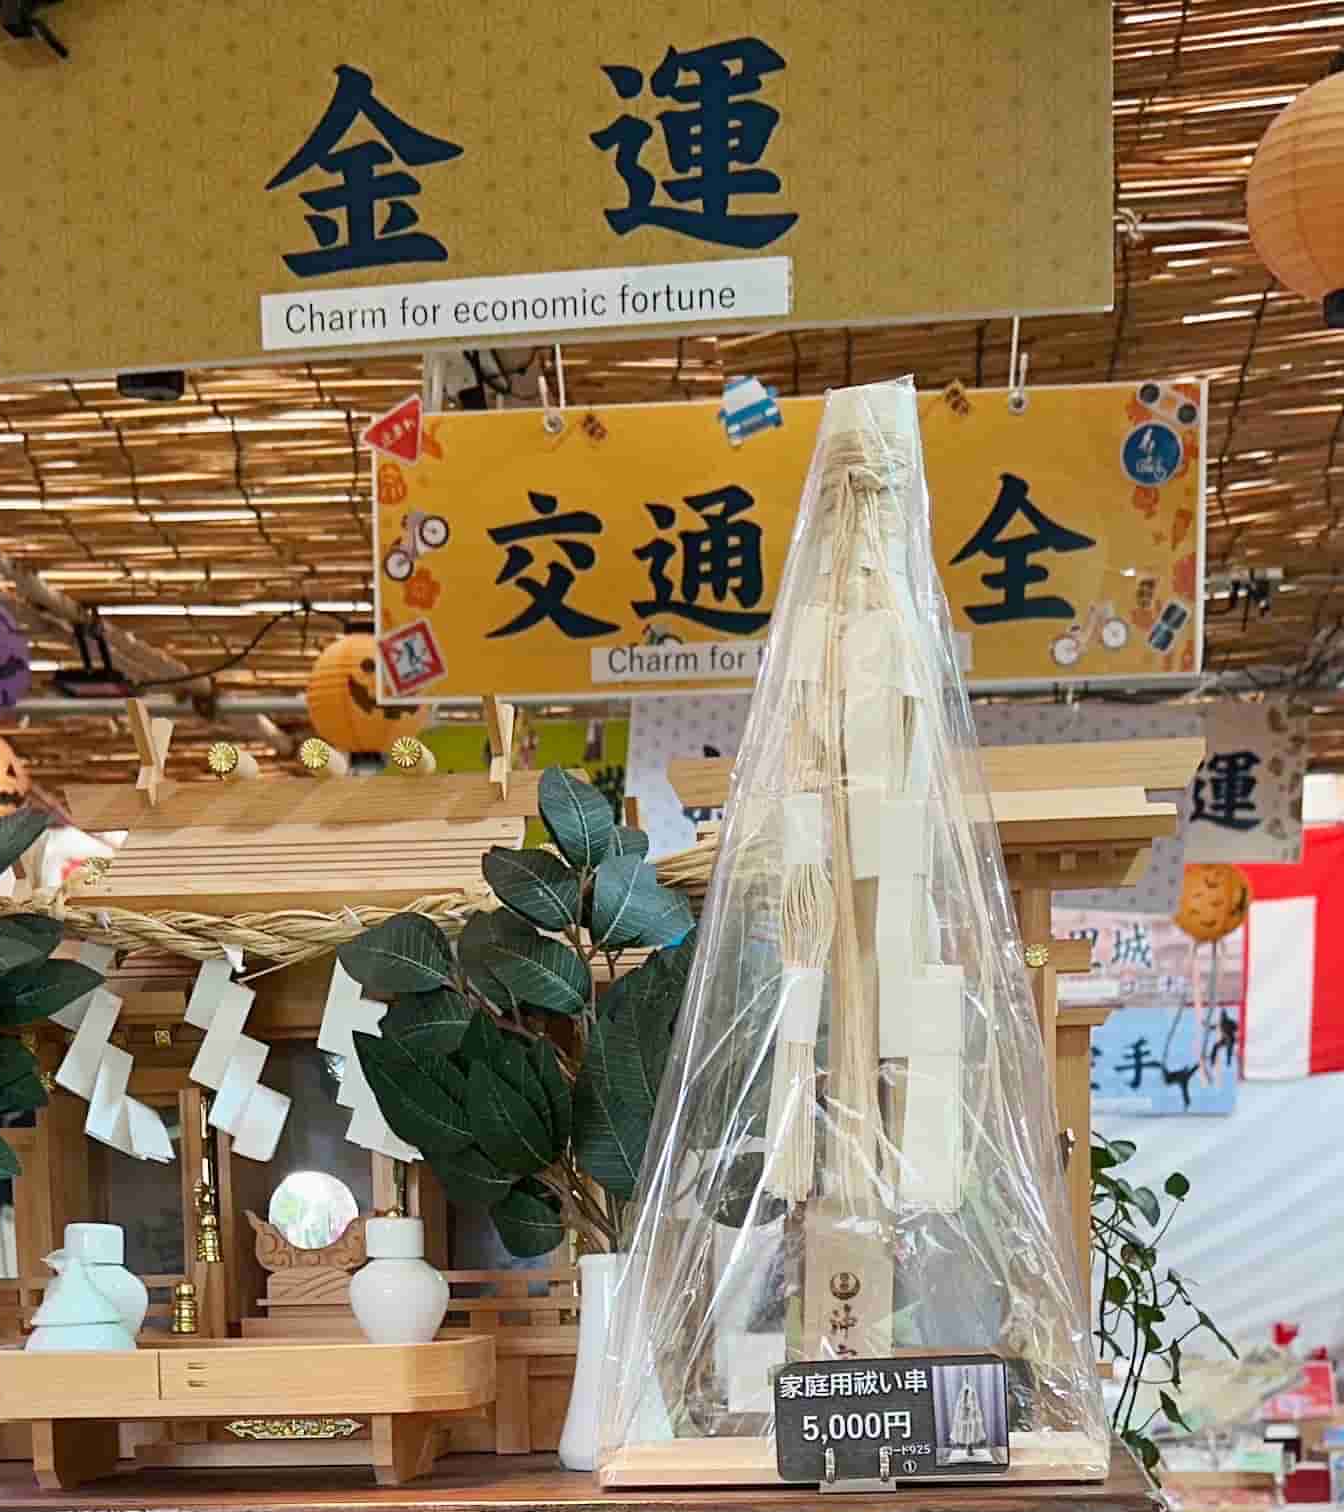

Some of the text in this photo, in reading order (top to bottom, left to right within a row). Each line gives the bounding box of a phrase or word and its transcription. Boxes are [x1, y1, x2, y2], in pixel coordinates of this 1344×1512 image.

[285, 283, 736, 334] Charm for economic fortune
[607, 645, 701, 674] Charm
[707, 644, 746, 672] for
[778, 1368, 929, 1400] 家庭用祓い串
[802, 1411, 913, 1444] 5,000円
